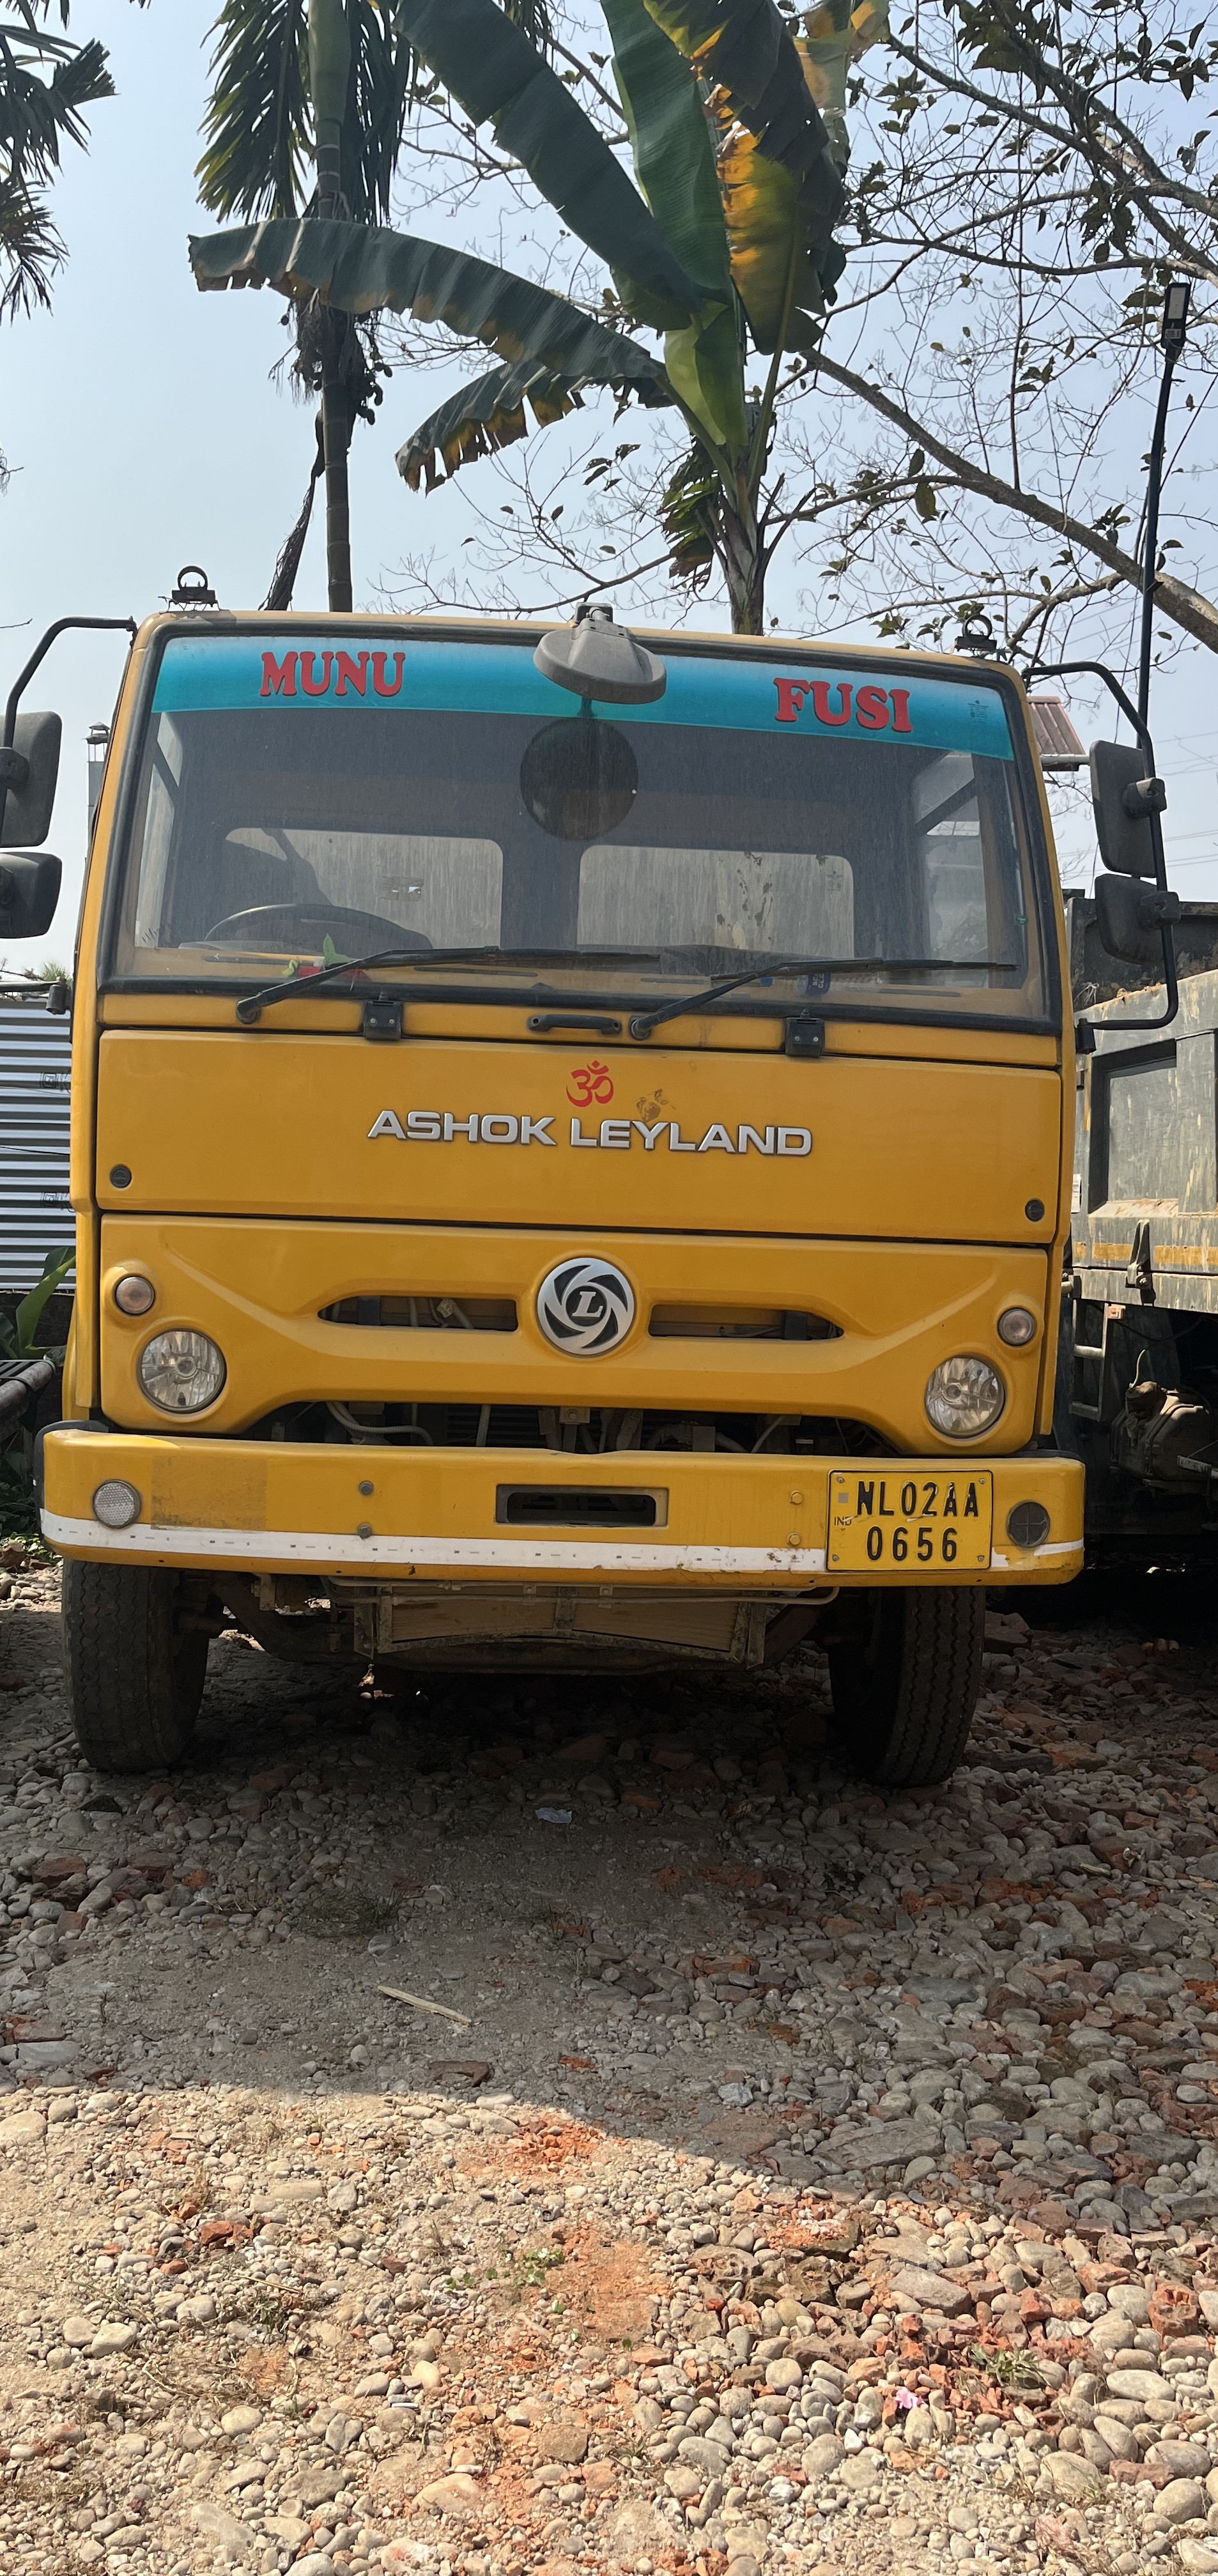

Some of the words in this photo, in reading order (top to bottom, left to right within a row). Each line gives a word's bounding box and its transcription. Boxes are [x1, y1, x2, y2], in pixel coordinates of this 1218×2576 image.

[259, 650, 406, 697] MUNU
[774, 678, 913, 733] FUSI
[367, 1110, 557, 1147] ASHOK
[569, 1117, 813, 1157] LEYLAND
[856, 1480, 979, 1517] NL02AA
[833, 1516, 852, 1526] IND
[866, 1526, 958, 1562] 0656
